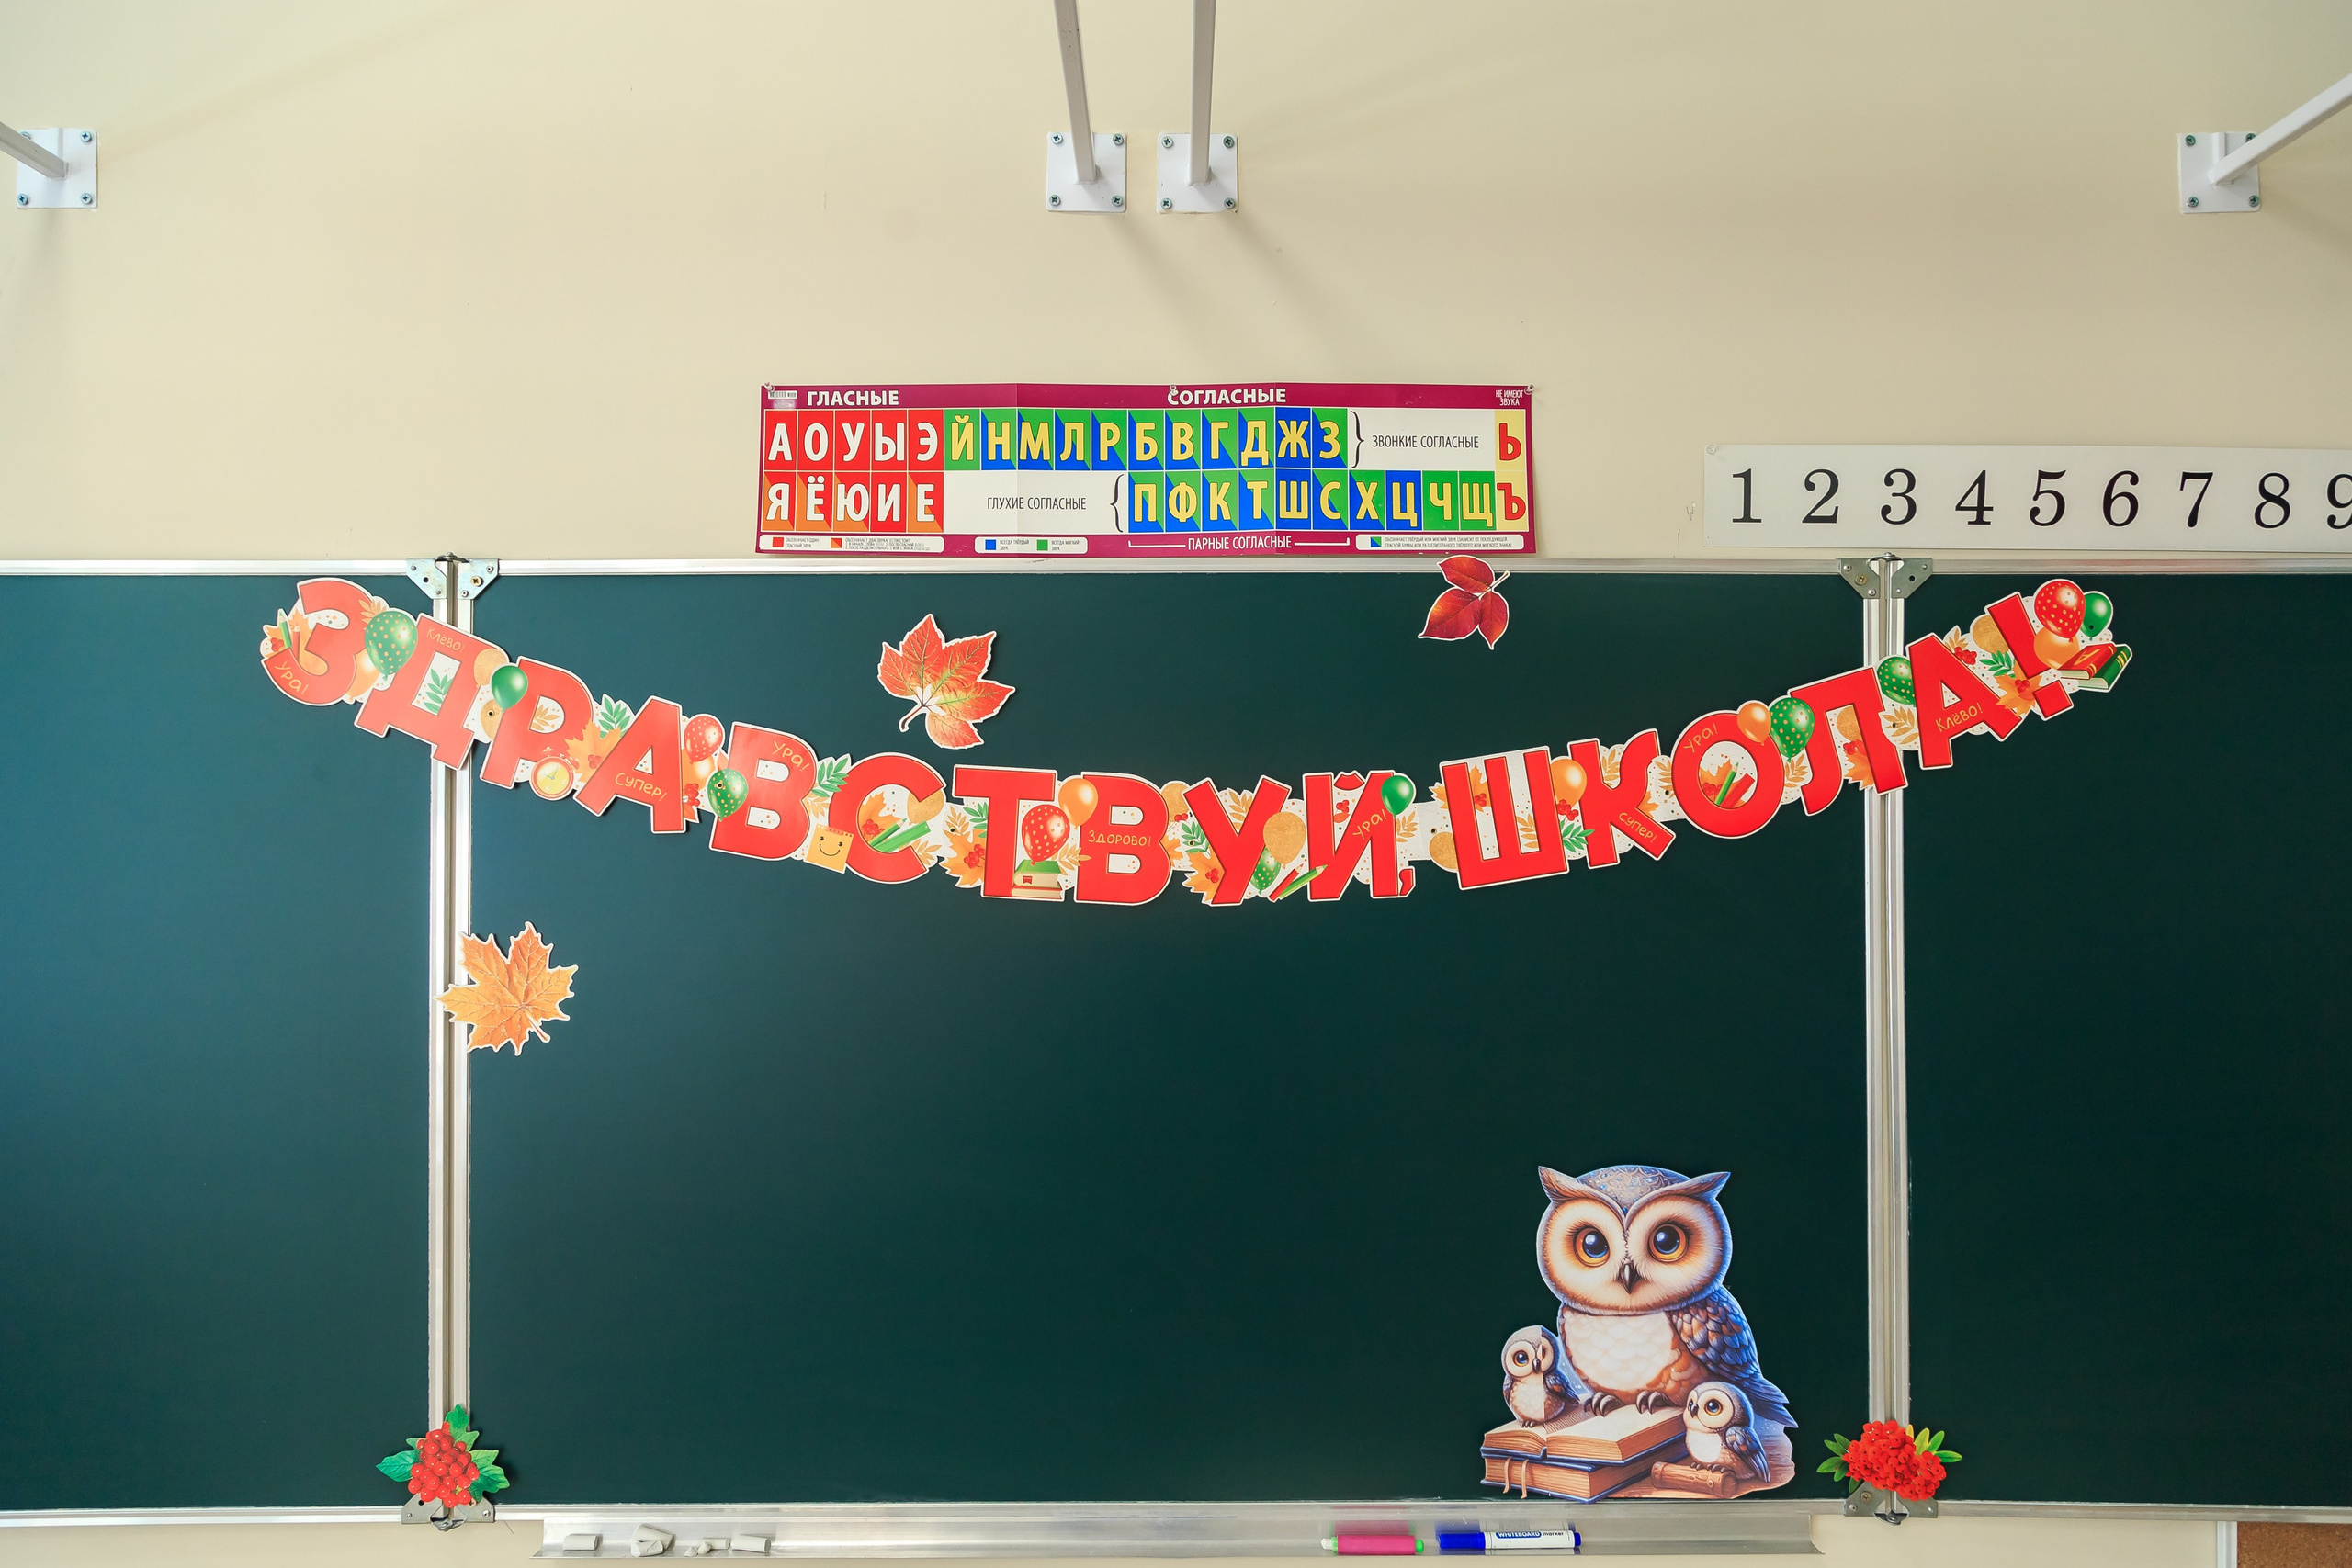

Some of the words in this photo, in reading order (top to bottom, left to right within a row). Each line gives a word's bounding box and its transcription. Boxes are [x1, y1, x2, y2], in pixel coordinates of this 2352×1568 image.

[807, 390, 899, 406] ГЛАСНЫЕ
[1167, 388, 1286, 405] СОГЛАСНЫЕ
[1495, 389, 1503, 398] НЕ
[1504, 389, 1523, 398] ИМЕЮТ
[1499, 398, 1520, 406] ЗВУКА
[768, 423, 793, 462] А
[803, 423, 829, 462] О
[842, 423, 865, 462] У
[875, 423, 905, 462] Ы
[917, 422, 938, 461] Э
[951, 414, 975, 461] Й
[987, 422, 1011, 461] Н
[1020, 422, 1051, 461] М
[1060, 422, 1084, 461] Л
[1099, 422, 1121, 461] Р
[1136, 423, 1159, 461] Б
[1172, 422, 1195, 461] В
[1210, 422, 1229, 460] Г
[1241, 420, 1270, 467] Д
[1277, 419, 1310, 459] Ж
[1318, 419, 1340, 459] З
[1372, 434, 1418, 448] ЗВОНКИЕ
[1420, 434, 1479, 449] СОГЛАСНЫЕ
[1498, 423, 1521, 461] Ь
[766, 483, 790, 523] Я
[806, 475, 825, 522] Ё
[835, 482, 869, 523] Ю
[877, 483, 901, 522] И
[917, 483, 935, 522] Е
[987, 497, 1024, 511] ГЛУХИЕ
[1027, 497, 1086, 511] СОГЛАСНЫЕ
[1134, 483, 1157, 523] П
[1168, 481, 1198, 523] Ф
[1209, 481, 1231, 521] К
[1247, 480, 1268, 520] Т
[1279, 479, 1308, 520] Ш
[1319, 480, 1340, 521] С
[1355, 481, 1379, 521] Х
[1393, 481, 1418, 527] Ц
[1430, 481, 1451, 521] Ч
[1463, 481, 1493, 528] Щ
[1497, 482, 1526, 521] Ъ
[1732, 468, 1762, 524] 1
[1802, 468, 1839, 525] 2
[1880, 468, 1917, 526] 3
[1955, 469, 1994, 525] 4
[2029, 469, 2066, 527] 5
[2101, 470, 2140, 527] 6
[2179, 471, 2214, 528] 7
[2254, 472, 2291, 529] 8
[2326, 473, 2352, 530] 9
[1187, 536, 1230, 550] ПАРНЫЕ
[1232, 536, 1292, 550] СОГЛАСНЫЕ
[275, 661, 309, 695] Ура!
[1443, 593, 2073, 887] ШКОЛА!
[1683, 723, 1718, 753] Ура!
[773, 740, 810, 772] Ура!
[616, 773, 667, 802] Супер!
[1352, 808, 1387, 840] Ура!
[1619, 812, 1657, 844] Супер!
